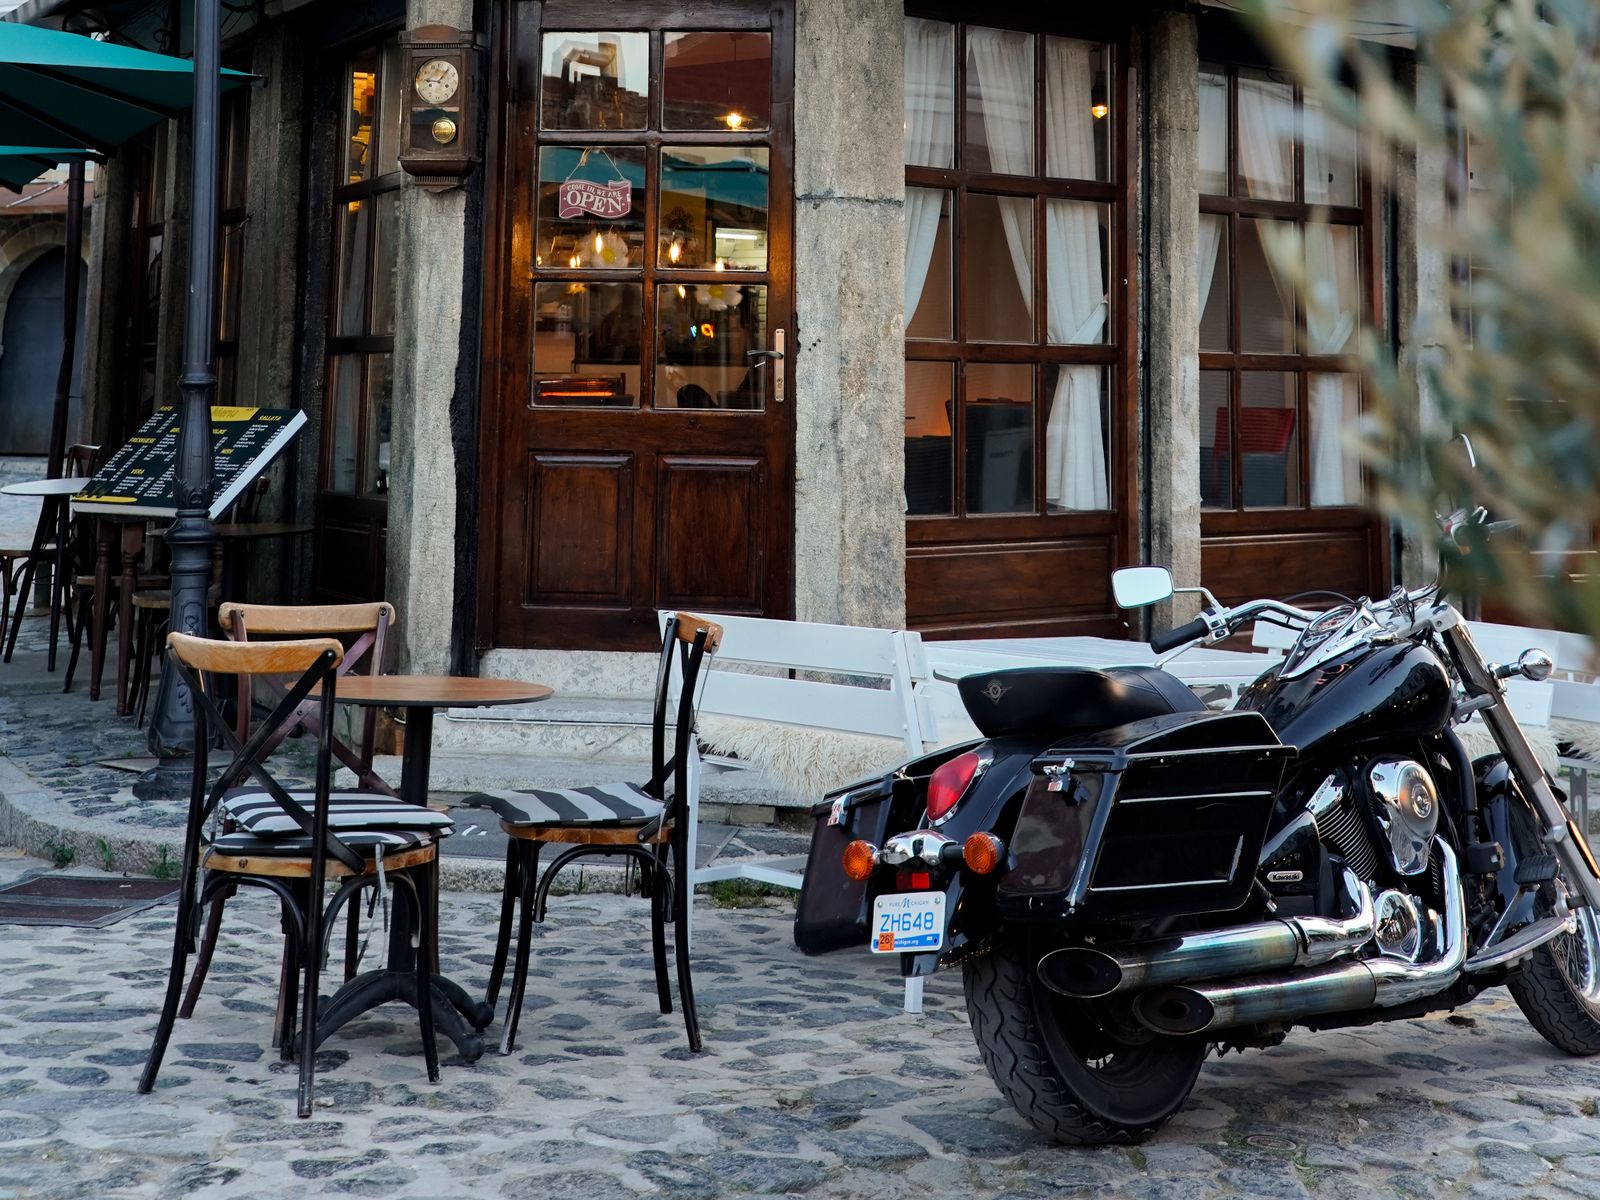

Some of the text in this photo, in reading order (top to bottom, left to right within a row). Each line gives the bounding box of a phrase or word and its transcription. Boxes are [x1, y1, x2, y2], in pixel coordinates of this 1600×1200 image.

[567, 183, 586, 191] COME
[608, 190, 622, 198] ARE
[566, 190, 624, 213] OPEN
[1271, 872, 1300, 881] Kawasaki
[879, 911, 934, 932] ZH648
